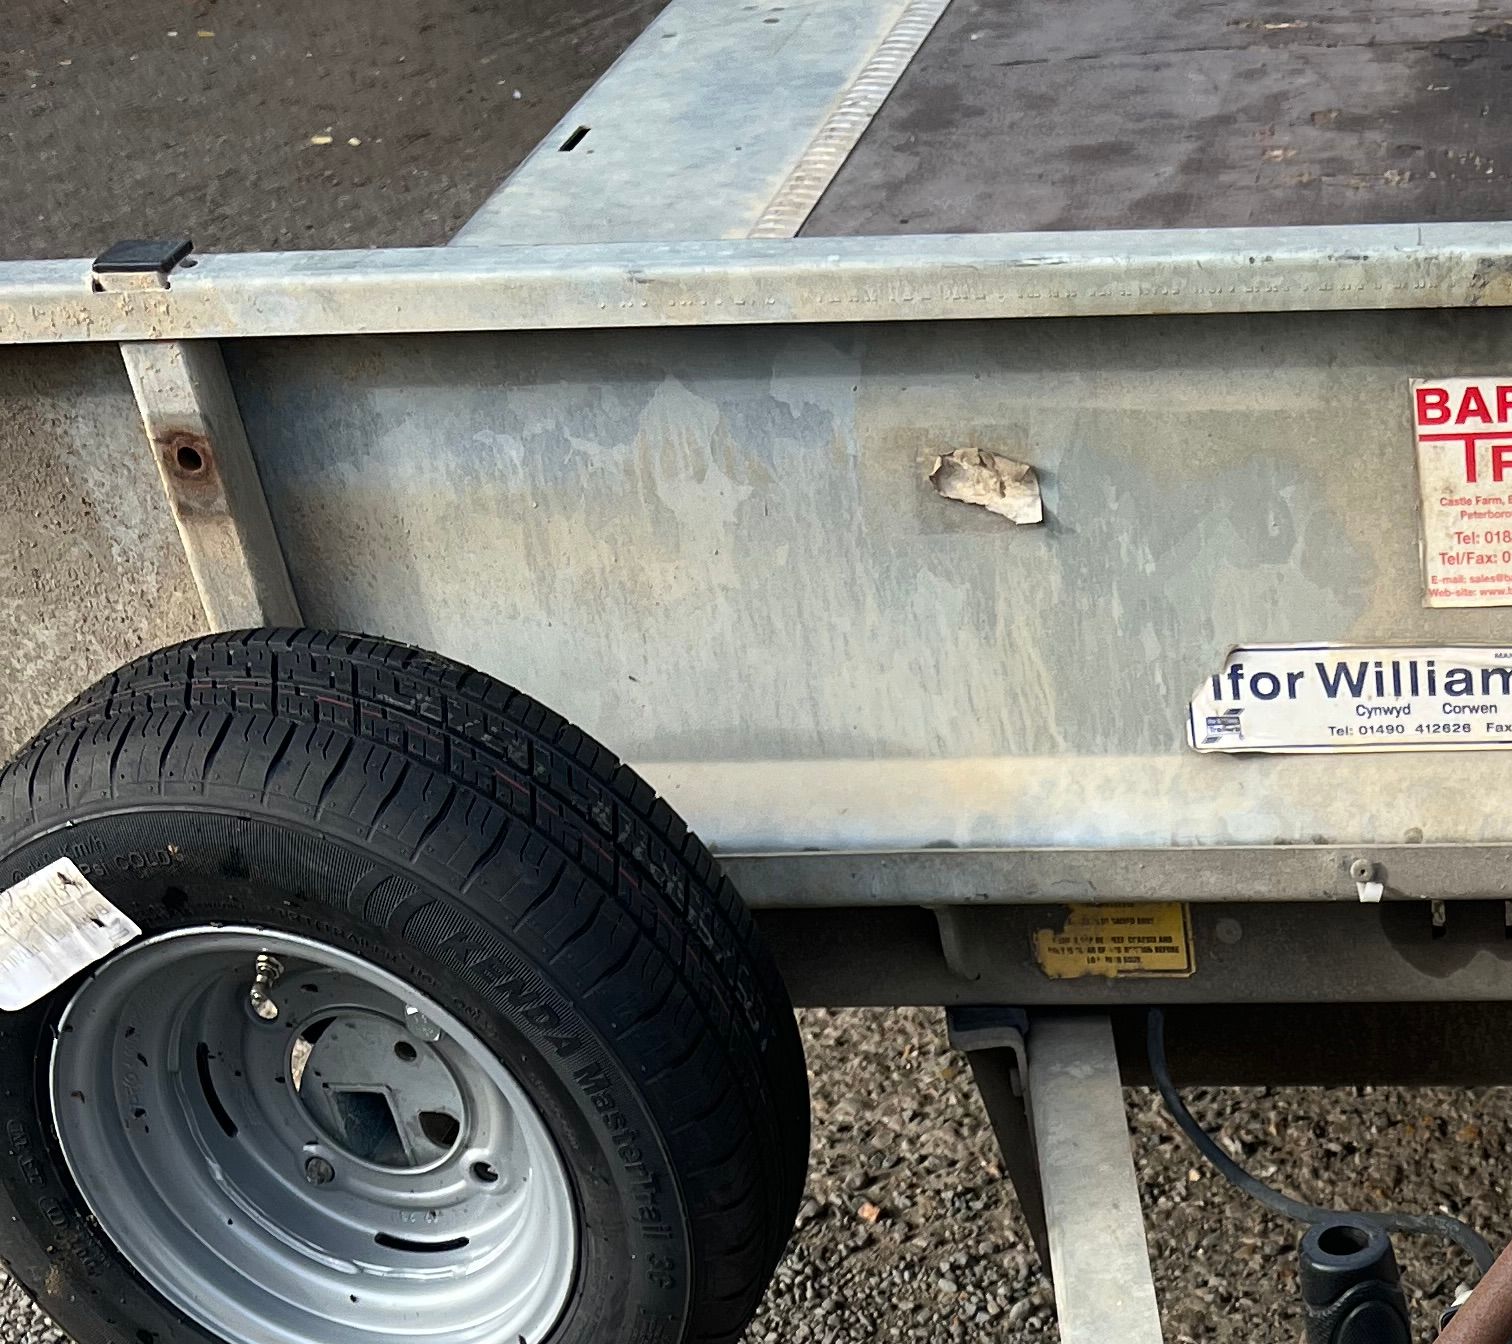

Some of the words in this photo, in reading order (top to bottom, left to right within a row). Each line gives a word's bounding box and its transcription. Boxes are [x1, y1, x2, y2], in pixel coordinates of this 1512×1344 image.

[1439, 497, 1473, 507] Castle
[1475, 496, 1505, 506] Farm,
[1455, 531, 1480, 545] Tel:
[1439, 551, 1498, 566] Tel/Fax:
[1431, 574, 1466, 585] E-mail:
[1428, 587, 1477, 598] Web-site:
[1355, 703, 1412, 718] Cynwyd
[1442, 701, 1498, 715] Corwen
[1328, 725, 1354, 737] Tel:
[1359, 723, 1405, 736] 01490
[1414, 722, 1472, 734] 412626
[439, 930, 583, 1060] KENDA
[572, 1060, 674, 1241] MasterTrail
